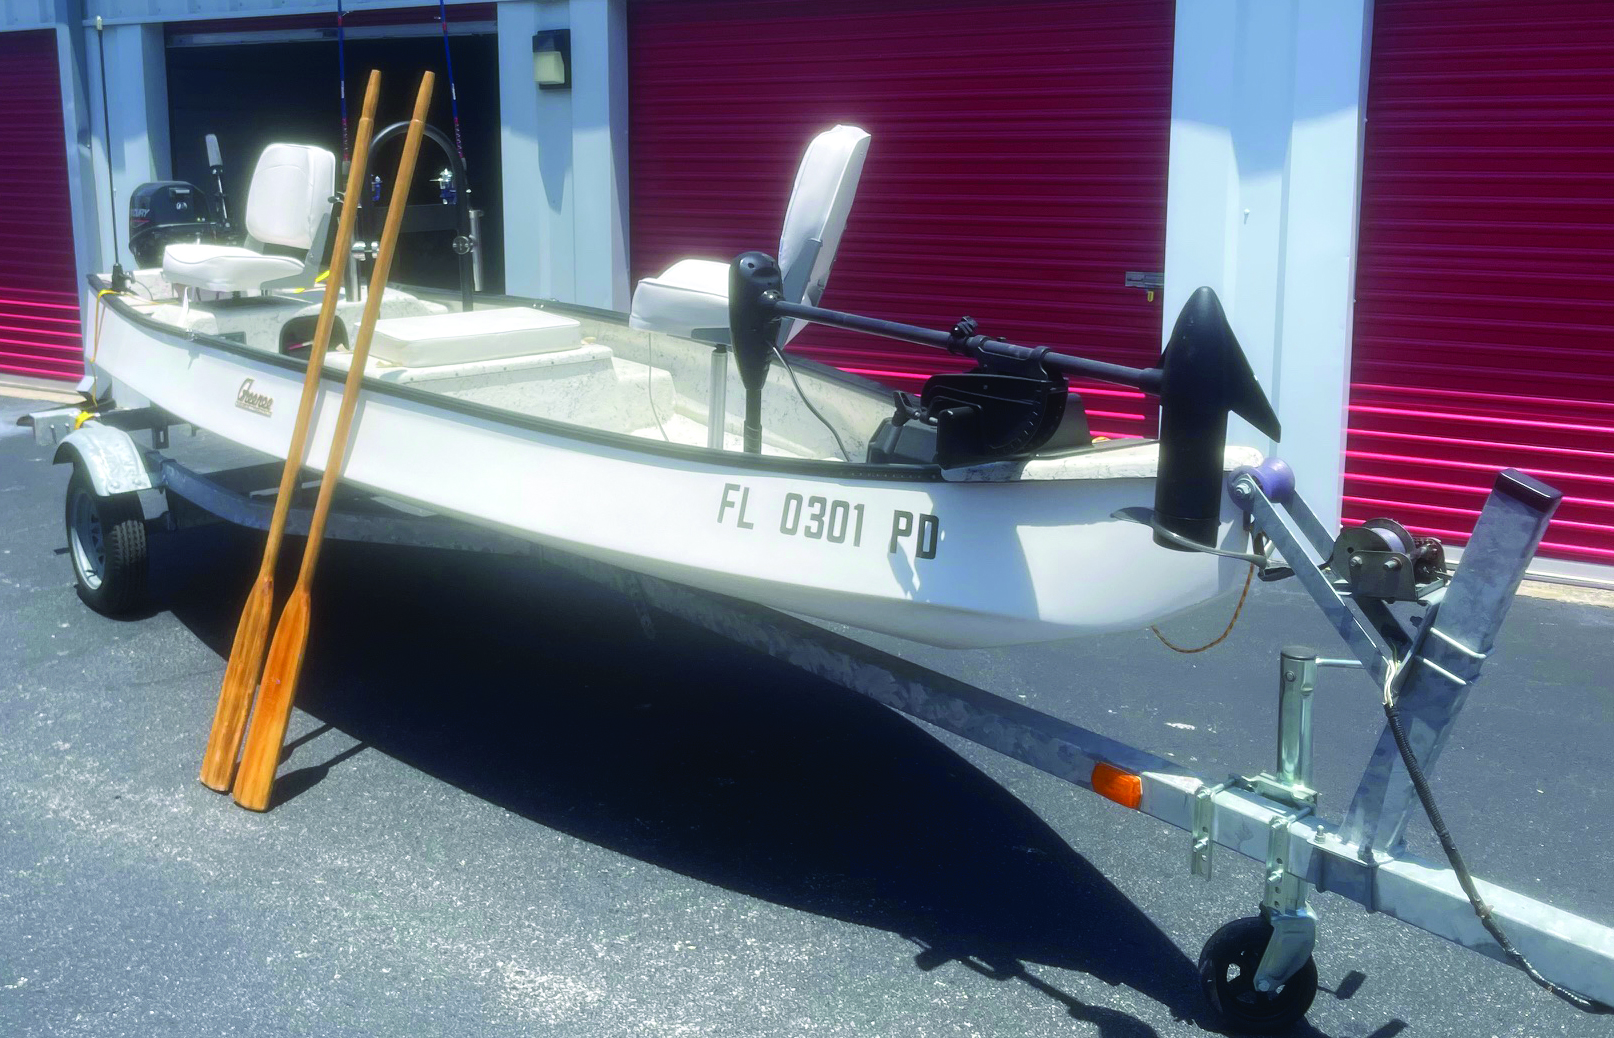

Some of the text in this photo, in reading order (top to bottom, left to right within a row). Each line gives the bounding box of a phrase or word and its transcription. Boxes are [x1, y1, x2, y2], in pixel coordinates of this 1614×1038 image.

[130, 208, 151, 218] CURY
[716, 482, 940, 560] FL 0301 PD
